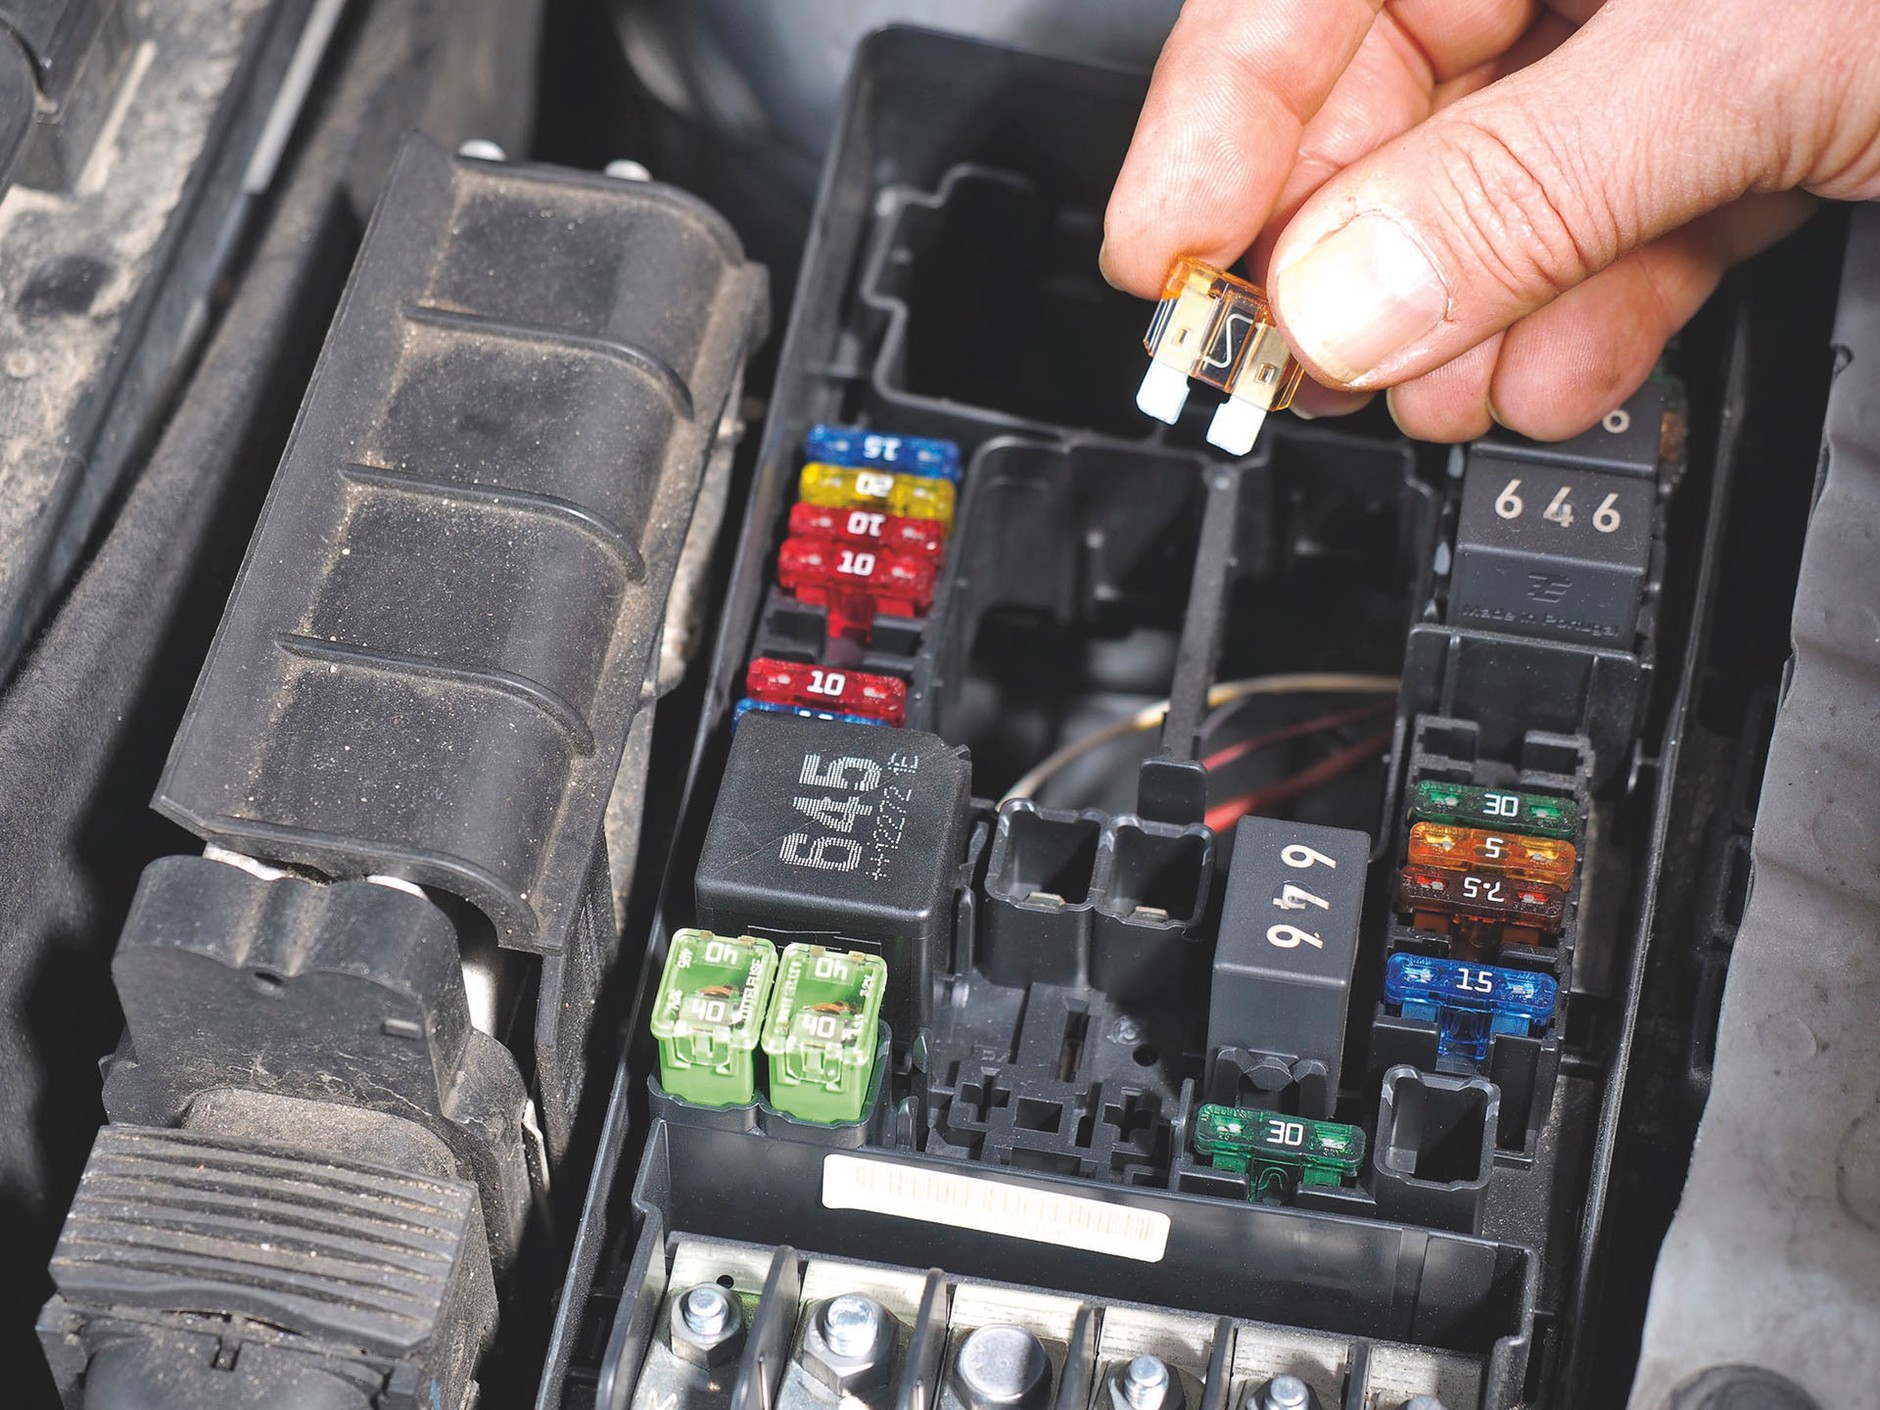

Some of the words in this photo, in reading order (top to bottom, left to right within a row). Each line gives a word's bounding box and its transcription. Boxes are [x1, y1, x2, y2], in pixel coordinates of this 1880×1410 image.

[863, 436, 902, 461] 15
[855, 473, 894, 496] 20
[847, 512, 886, 538] 10
[836, 551, 876, 577] 10
[807, 670, 846, 696] 10
[779, 753, 882, 872] 645
[1483, 793, 1520, 817] 30
[1484, 837, 1505, 859] 5
[1266, 843, 1337, 950] 646
[1463, 876, 1505, 903] 7.5
[705, 942, 738, 965] 40
[815, 957, 848, 981] 40
[1455, 968, 1493, 993] 15
[690, 1001, 725, 1022] 40
[802, 1016, 836, 1038] 40
[1266, 1120, 1304, 1147] 30
